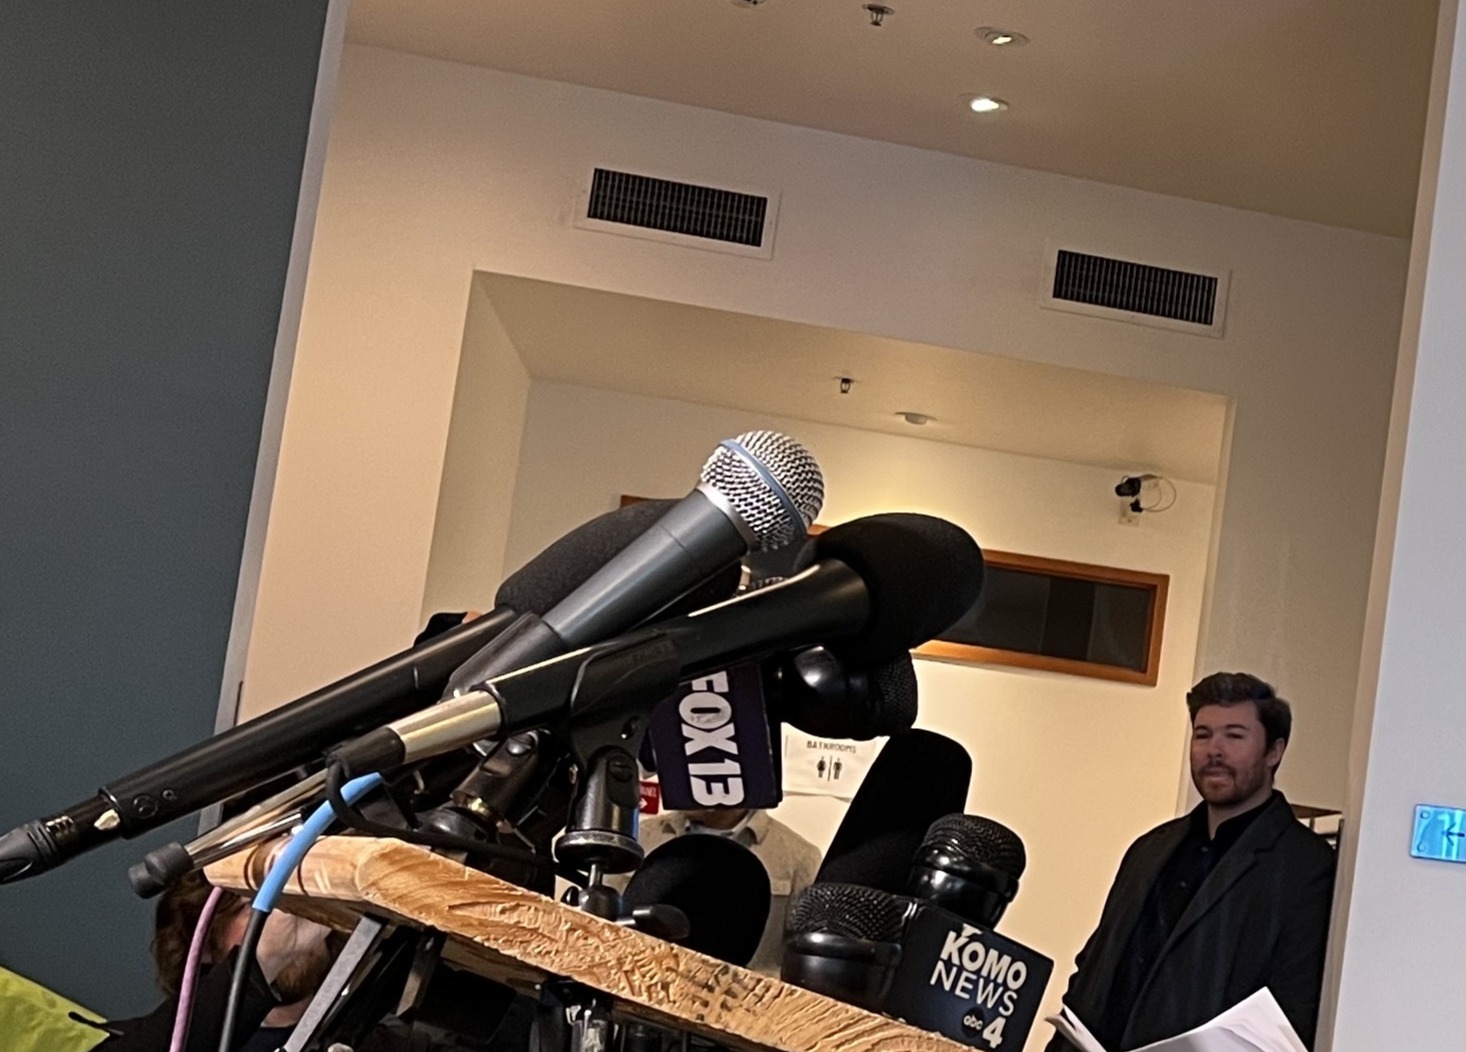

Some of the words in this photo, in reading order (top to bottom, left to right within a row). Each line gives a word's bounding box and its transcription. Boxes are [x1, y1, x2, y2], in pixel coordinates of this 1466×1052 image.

[940, 923, 1027, 990] KOMO
[930, 960, 1018, 1016] NEWS
[963, 1014, 985, 1030] abc
[982, 1016, 1007, 1049] 4
